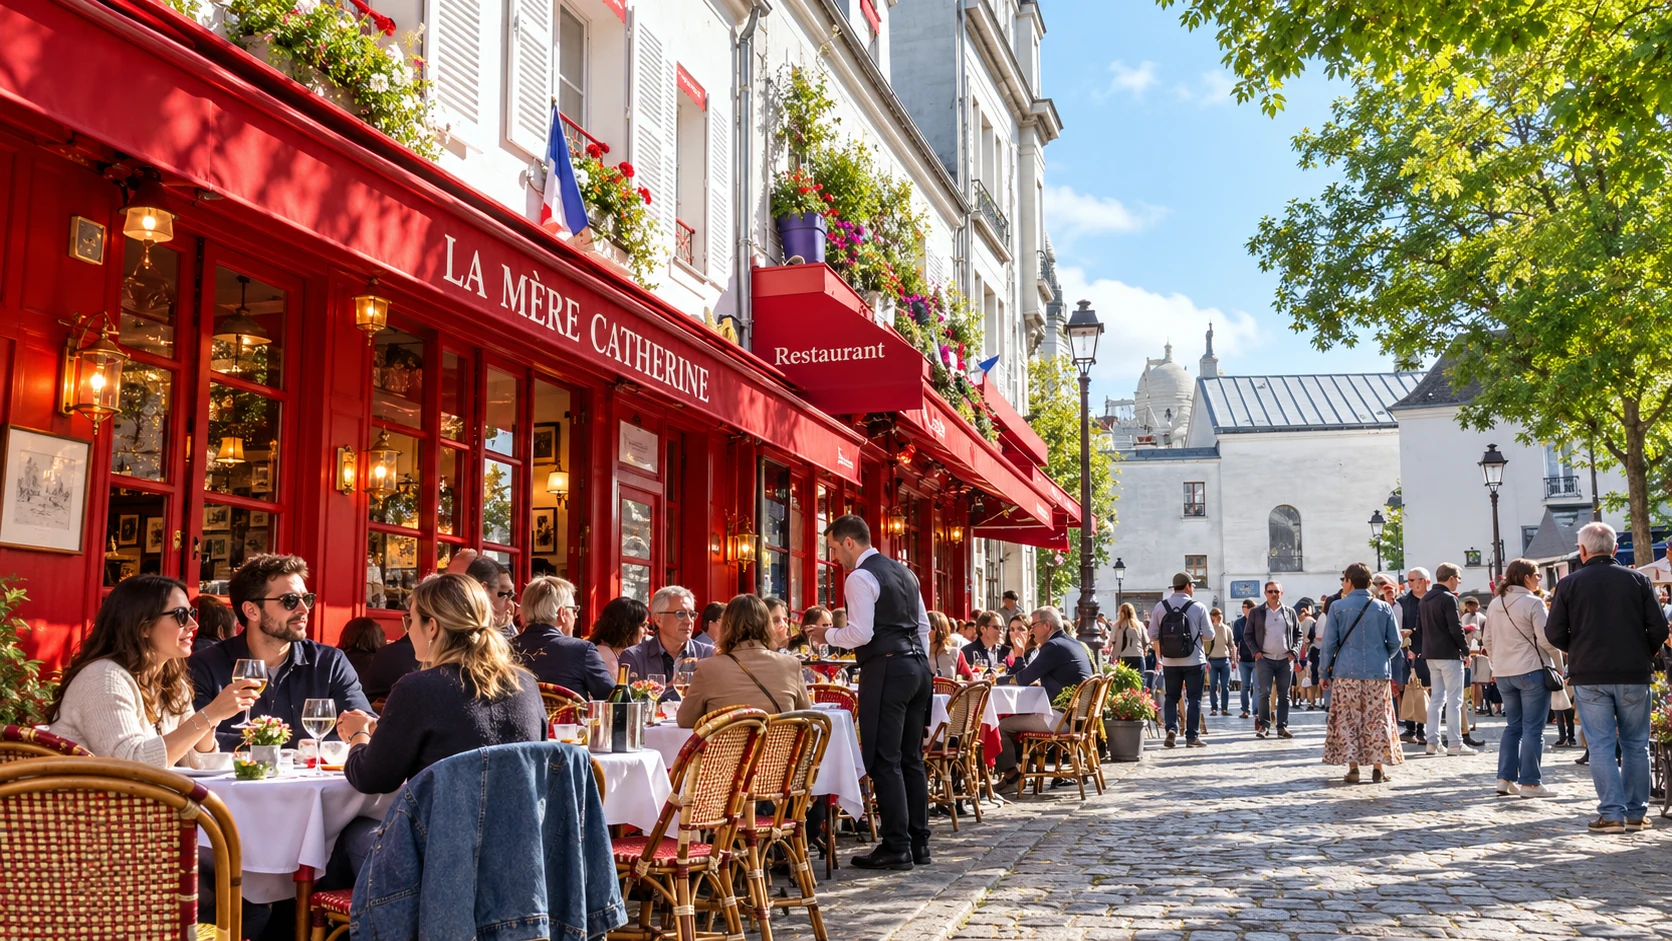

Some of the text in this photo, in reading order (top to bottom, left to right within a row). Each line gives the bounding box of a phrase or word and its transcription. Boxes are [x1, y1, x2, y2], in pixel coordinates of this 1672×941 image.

[443, 233, 710, 403] LA MÈRE CATHERINE
[774, 341, 886, 366] Restaurant
